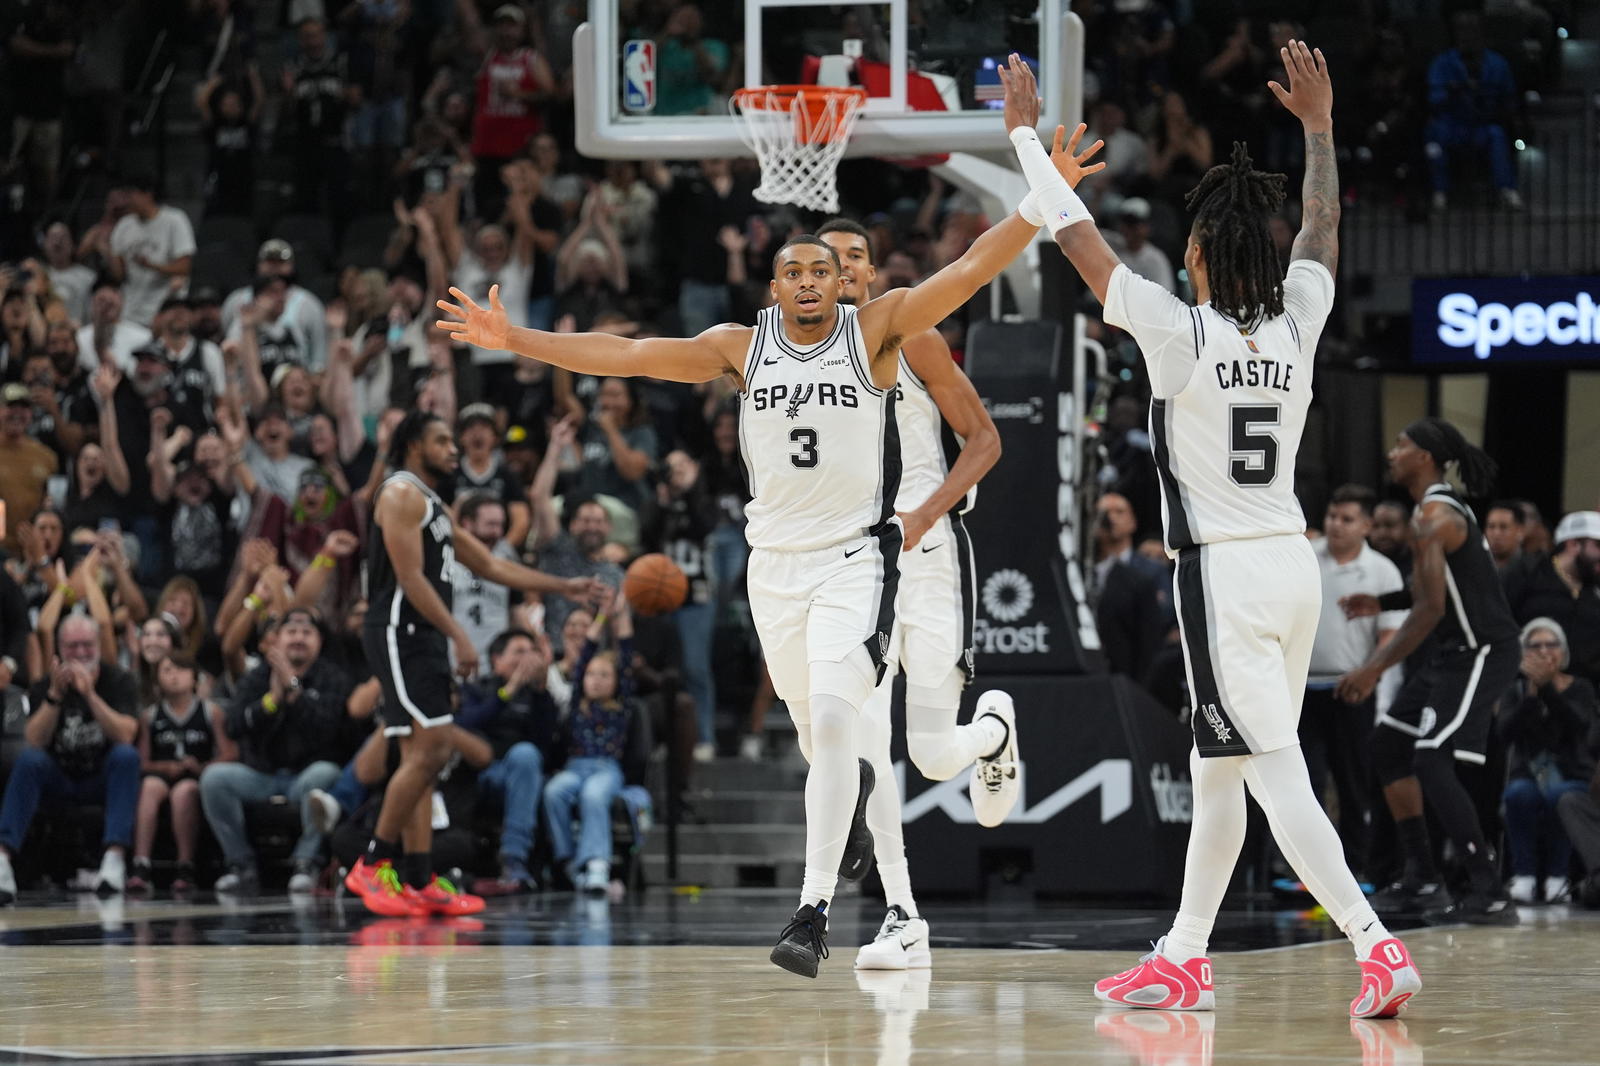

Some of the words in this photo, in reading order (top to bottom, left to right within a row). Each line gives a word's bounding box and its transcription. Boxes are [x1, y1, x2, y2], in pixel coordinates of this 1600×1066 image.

[823, 359, 847, 367] LEDGER
[1215, 360, 1293, 392] CASTLE
[753, 383, 859, 420] SPURS
[788, 426, 821, 470] 3
[1228, 403, 1281, 488] 5
[973, 618, 1050, 654] Frost
[893, 758, 1133, 824] KA
[1384, 943, 1404, 965] 0
[1201, 963, 1212, 986] 0
